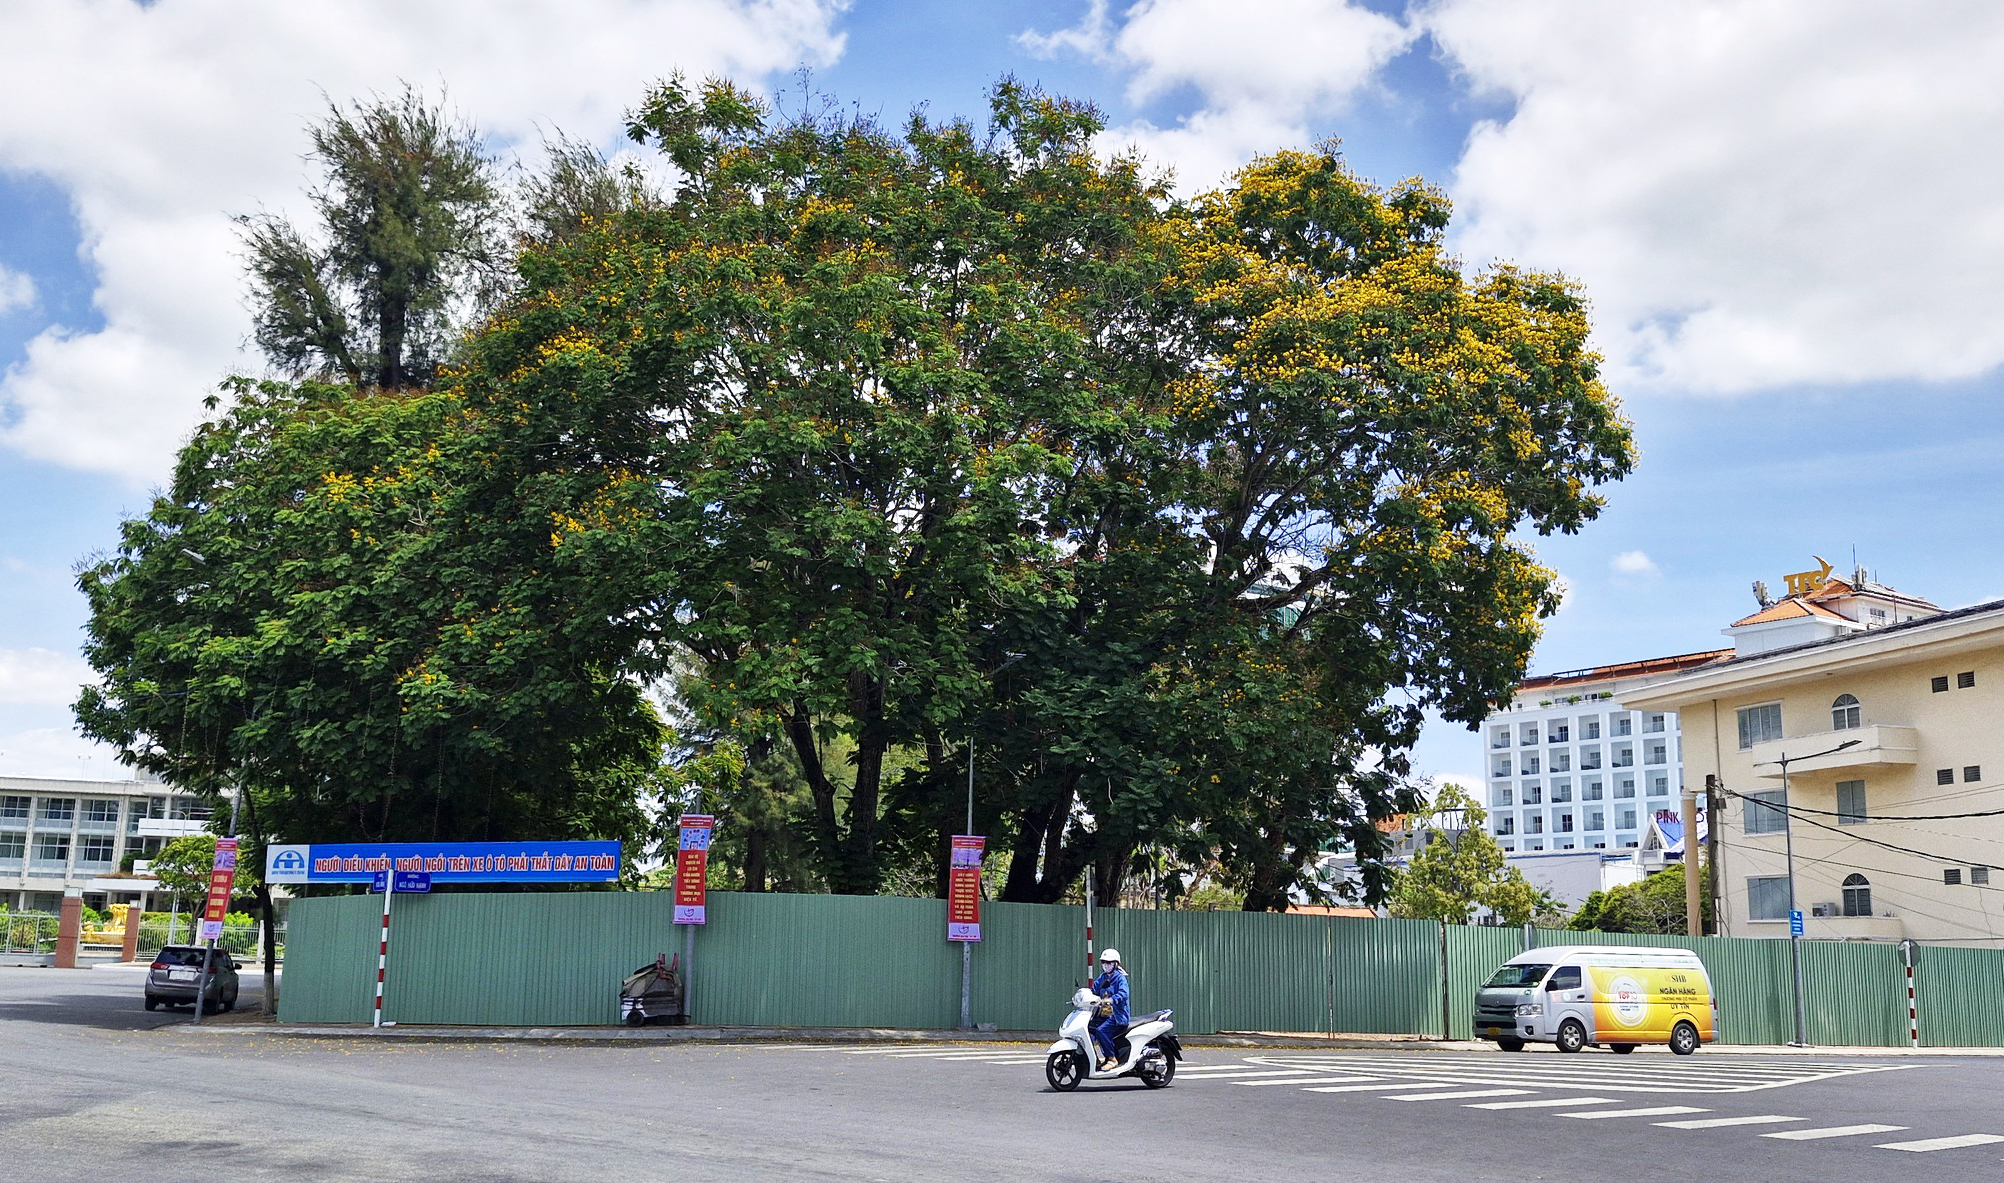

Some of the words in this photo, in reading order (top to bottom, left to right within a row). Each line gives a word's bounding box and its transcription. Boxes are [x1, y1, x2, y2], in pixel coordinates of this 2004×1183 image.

[1656, 811, 1680, 824] PINK
[314, 854, 342, 873] NGƯỜI
[364, 852, 392, 873] KHIỂN
[395, 854, 423, 873] NGƯỜI
[447, 854, 471, 872] TRÊN
[471, 856, 485, 872] XE
[486, 853, 493, 872] Ô
[494, 853, 506, 872] TÔ
[507, 852, 529, 872] PHẢI
[530, 851, 554, 872] THẮT
[554, 853, 573, 871] DÂY
[573, 855, 588, 871] AN
[590, 852, 615, 871] TOÀN
[1671, 974, 1687, 983] SHB
[1659, 986, 1678, 995] NGÂN
[1678, 986, 1697, 995] HÀNG
